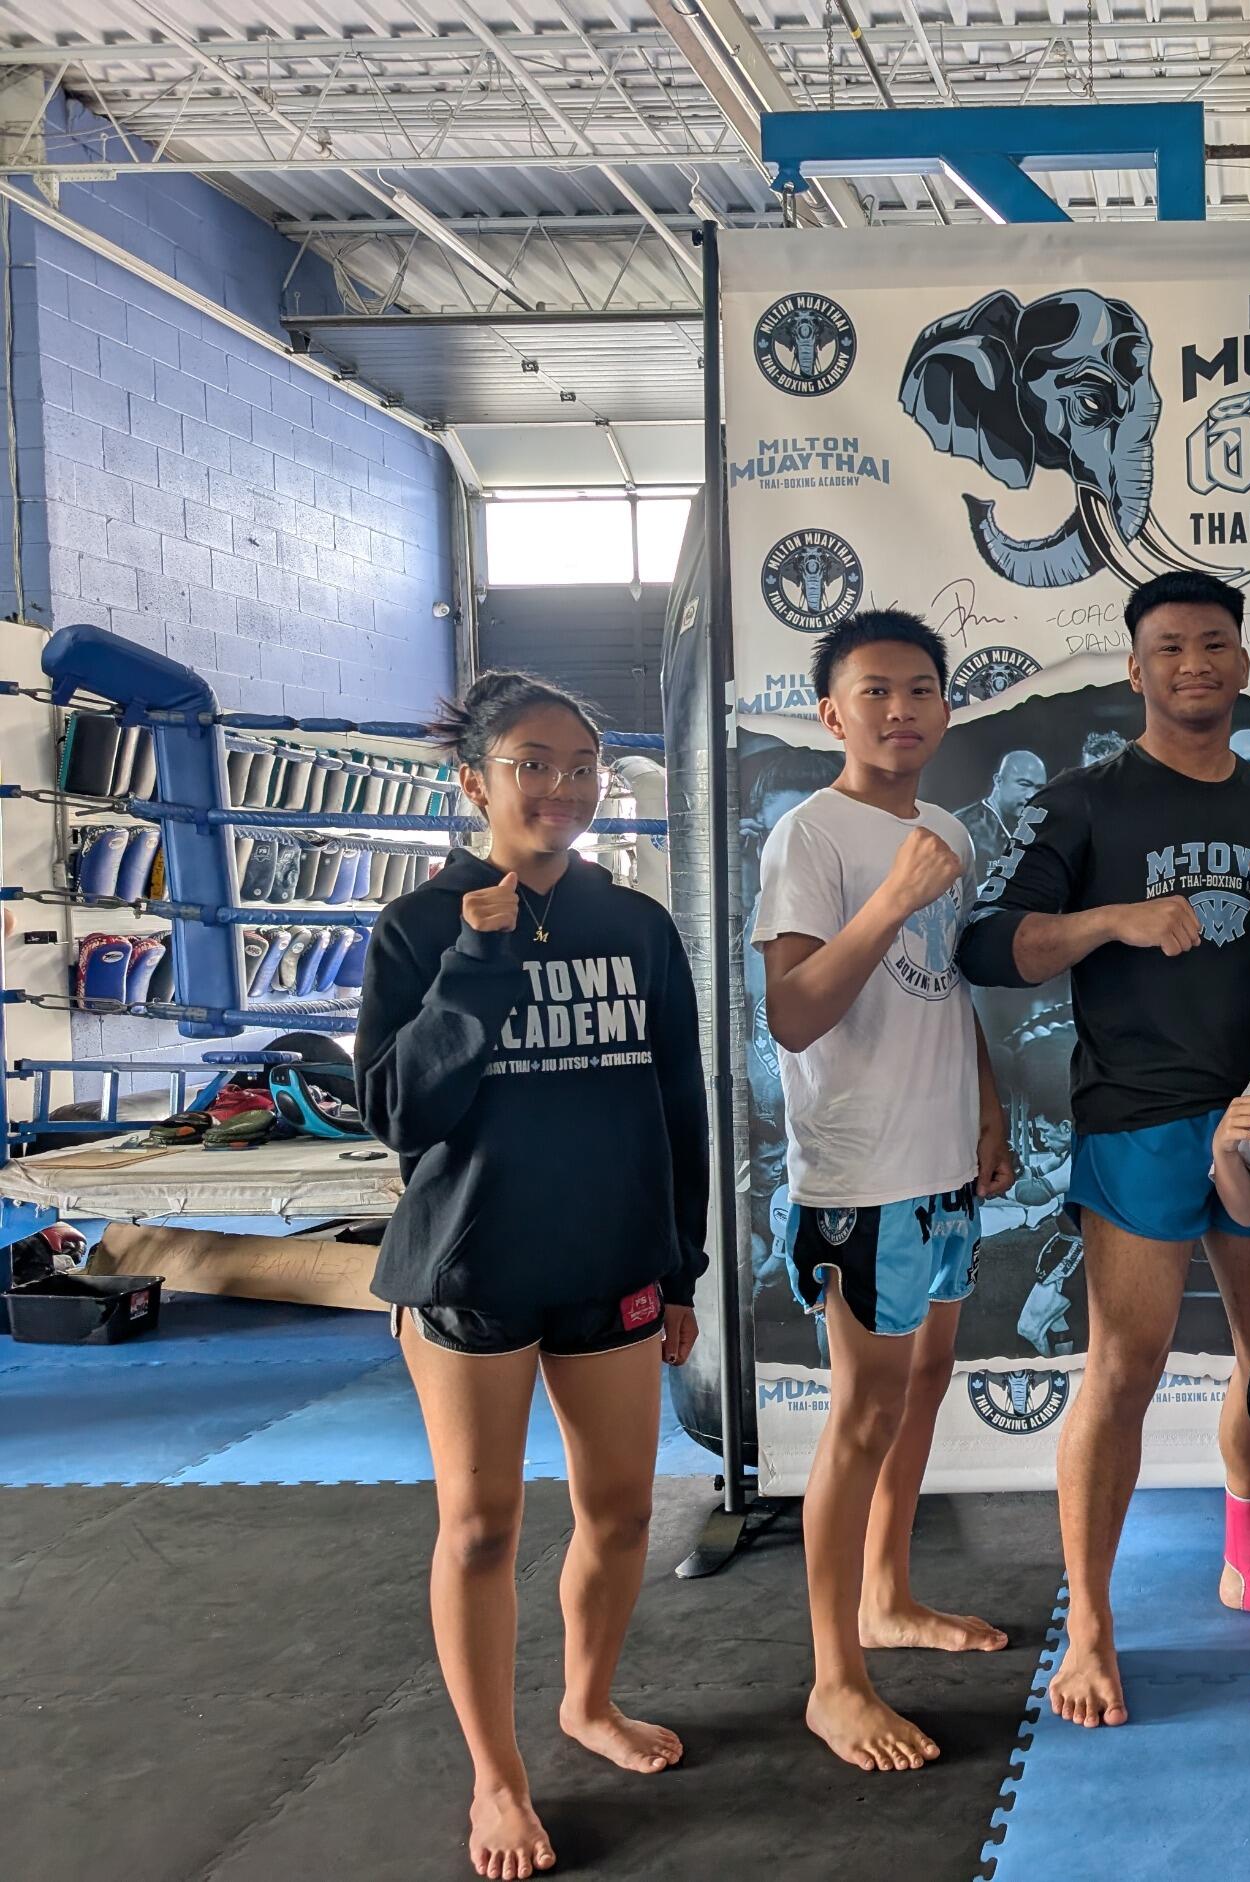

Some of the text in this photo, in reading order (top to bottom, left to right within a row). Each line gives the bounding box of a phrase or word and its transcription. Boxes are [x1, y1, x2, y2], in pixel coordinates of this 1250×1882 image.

[760, 297, 850, 334] MILTON MUAYTHAI
[761, 352, 850, 392] THAI-BOXING ACADEMY
[759, 437, 859, 456] MILTON
[730, 453, 890, 488] MUAYTHAI
[759, 475, 860, 490] THAI-BOXING ACADEMY
[768, 533, 856, 570] MILTON MUAYTHAI
[768, 587, 857, 628] THAI-BOXING ACADEMY
[765, 673, 815, 691] MIL
[955, 650, 1038, 688] MILTON MUAYTH
[737, 688, 818, 715] MUAY
[1146, 878, 1176, 900] MUAY
[1180, 874, 1243, 890] THAI-BOXING
[522, 956, 637, 1002] TOWN
[493, 999, 647, 1051] CADEMY
[541, 1058, 557, 1072] JIU
[559, 1056, 589, 1071] JITSU
[600, 1051, 653, 1067] ATHLETICS
[788, 1400, 830, 1411] THAI-BOX
[975, 1391, 1063, 1430] THAI-BOXING ACADEMY
[1152, 1392, 1208, 1403] HAI-BOXING
